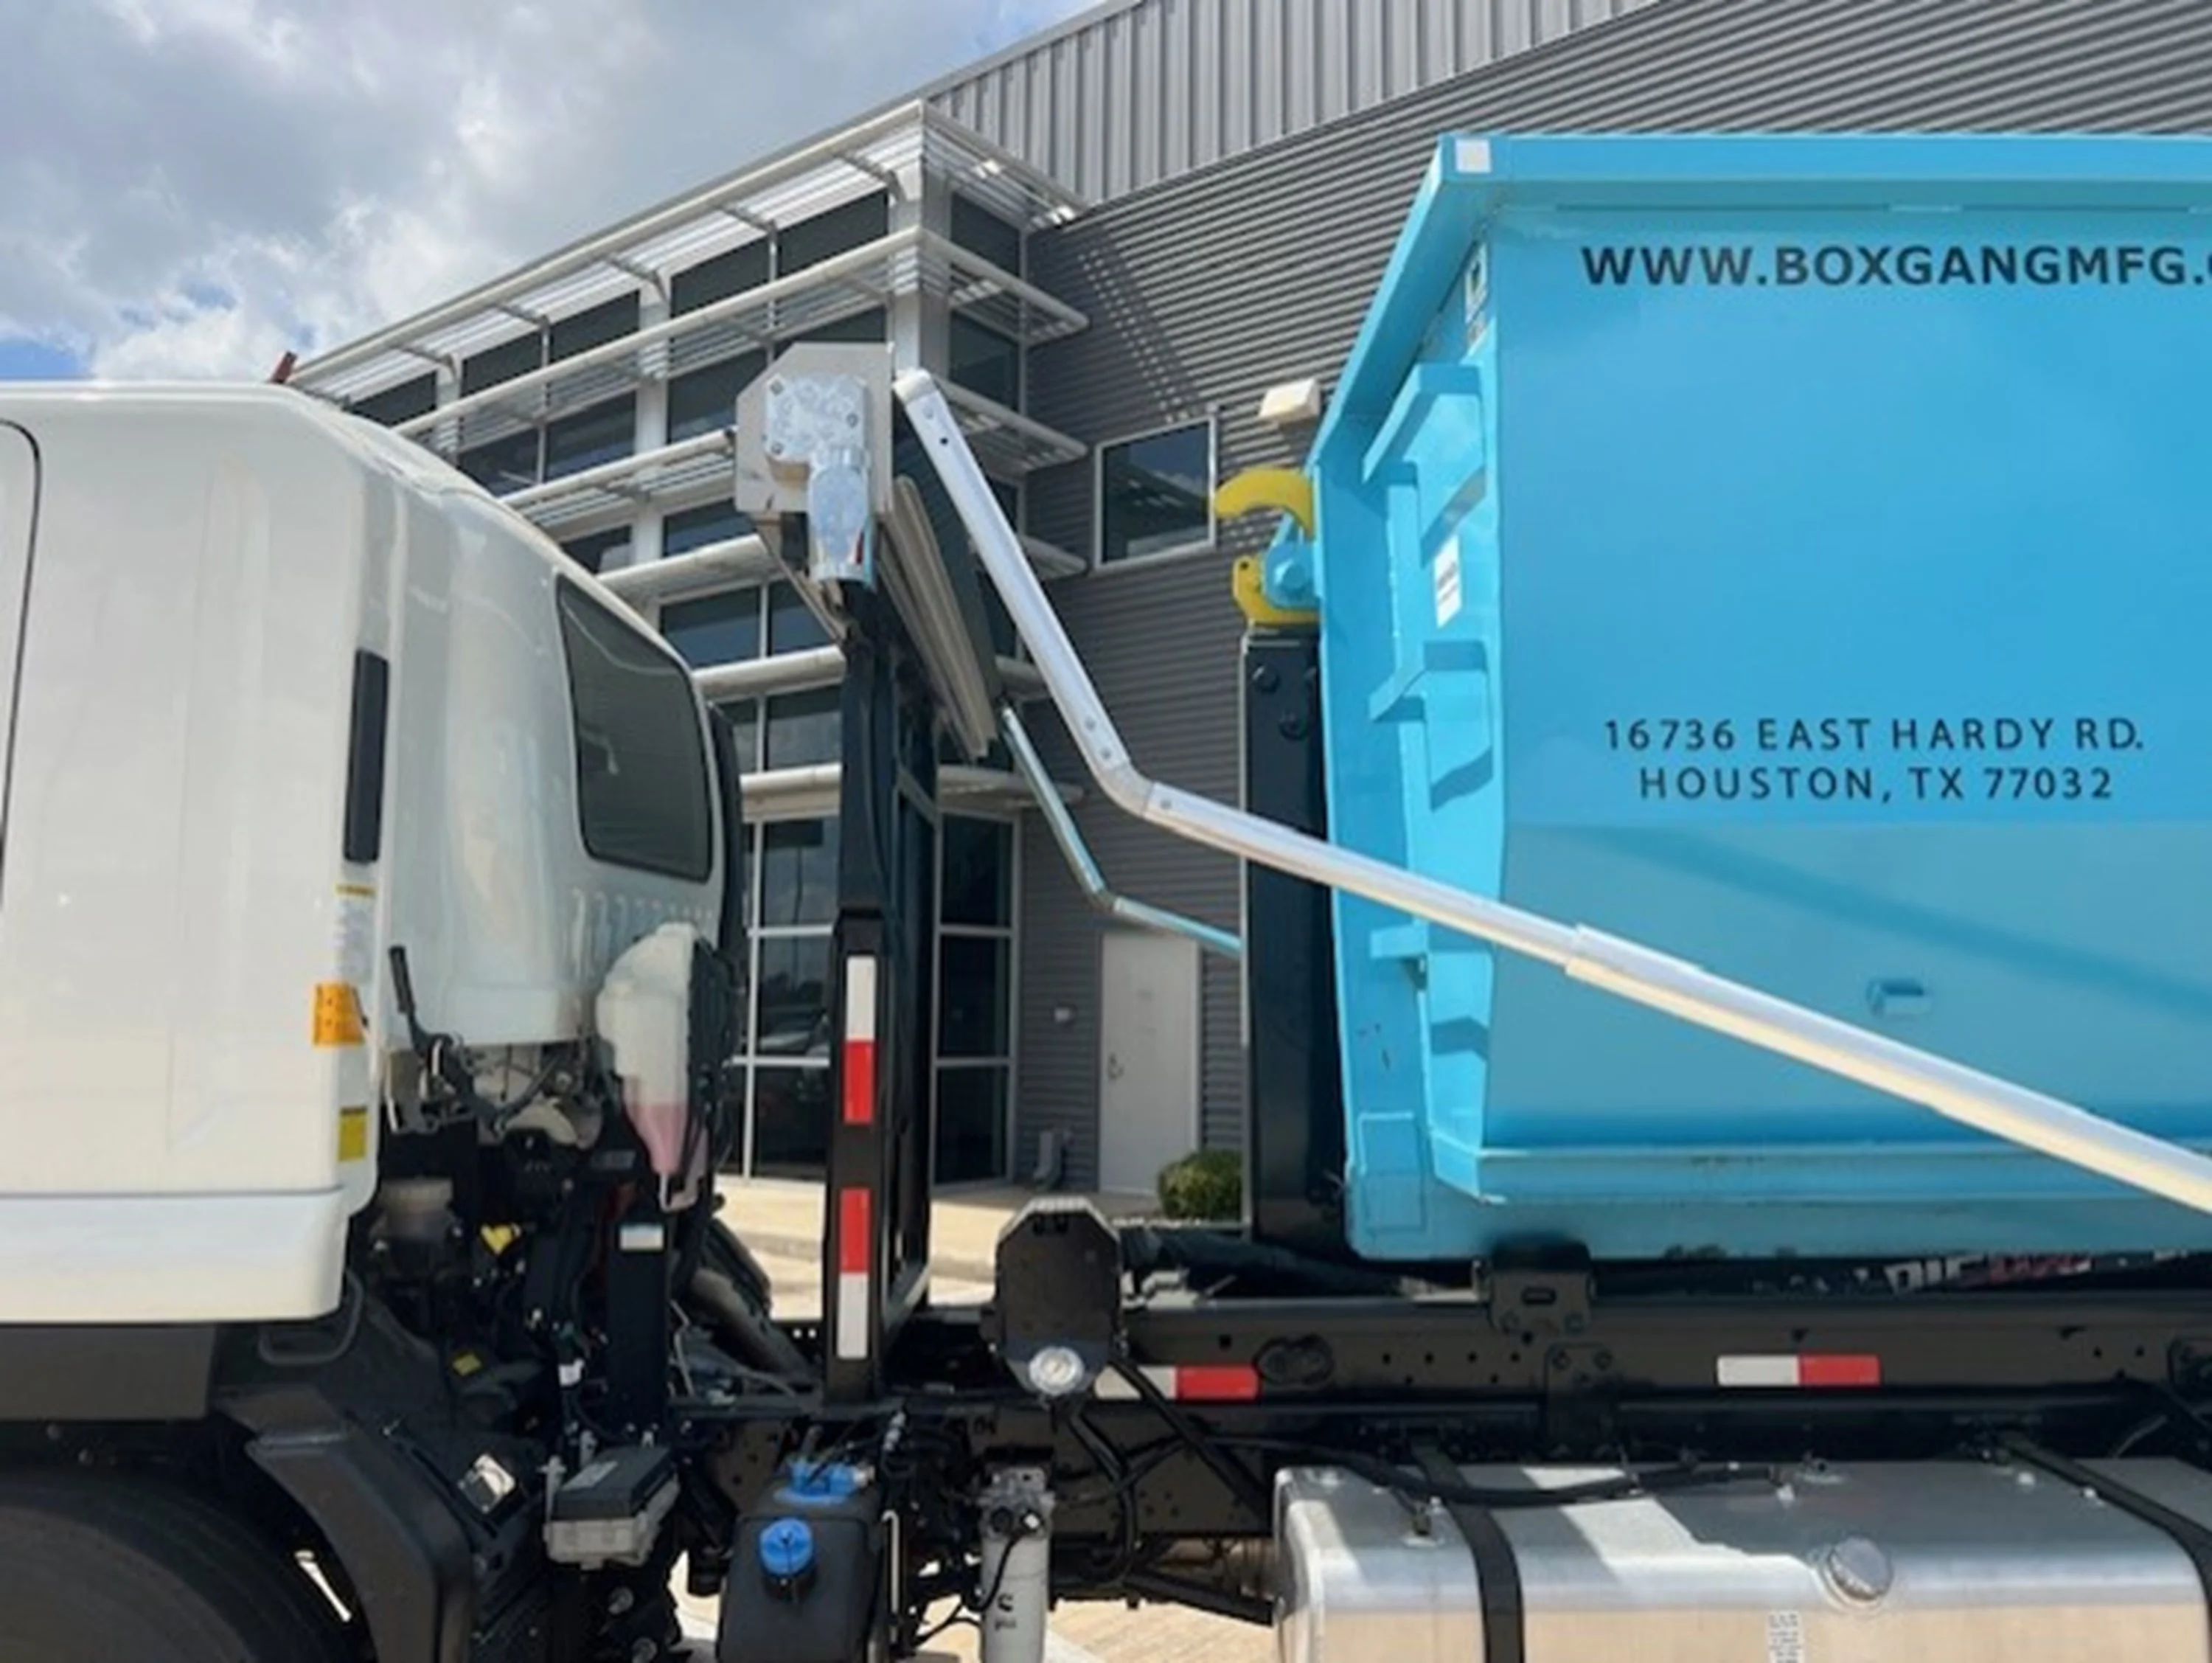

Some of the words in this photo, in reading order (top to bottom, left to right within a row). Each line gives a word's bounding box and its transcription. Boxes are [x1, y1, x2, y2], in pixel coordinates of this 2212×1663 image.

[1580, 246, 2212, 286] WWW.BOXGANGMFG.
[1605, 718, 1735, 751] 16736
[1757, 718, 1871, 751] EAST
[1891, 718, 2054, 751] HARDY
[2075, 718, 2144, 751] RD.
[1640, 766, 1891, 805] HOUSTON,
[1907, 766, 1964, 799] TX
[1983, 766, 2112, 799] 77032
